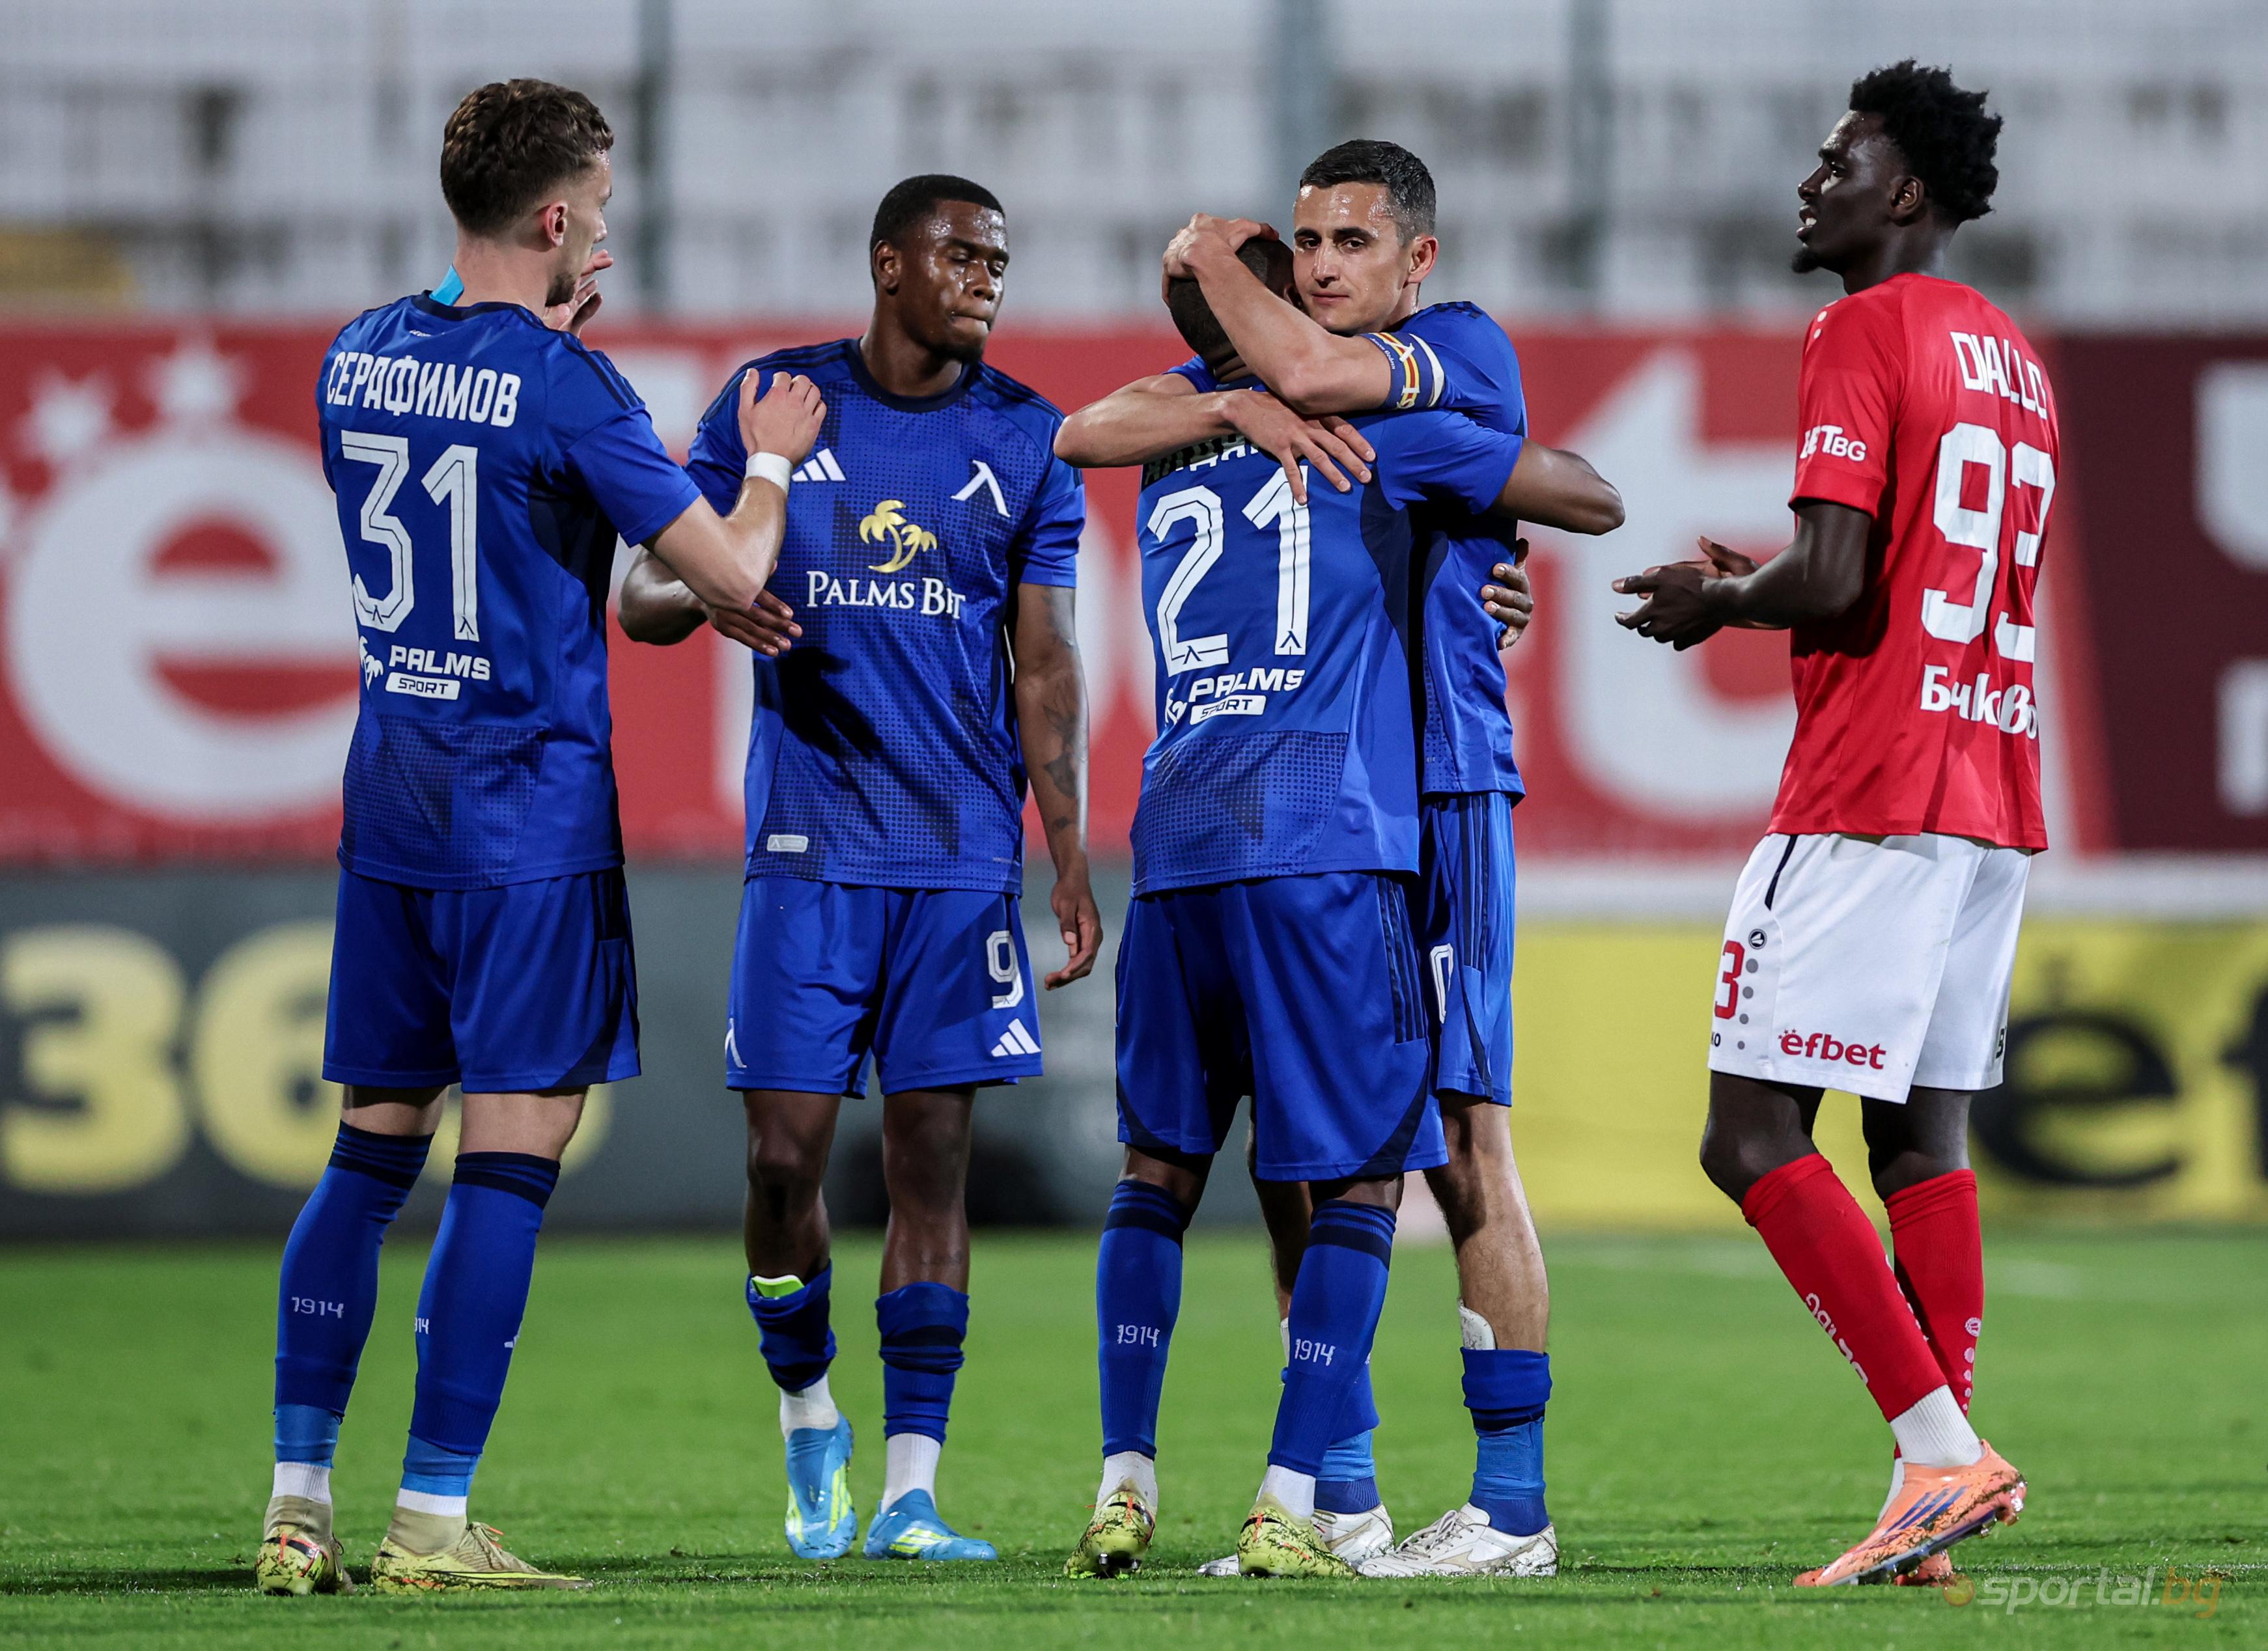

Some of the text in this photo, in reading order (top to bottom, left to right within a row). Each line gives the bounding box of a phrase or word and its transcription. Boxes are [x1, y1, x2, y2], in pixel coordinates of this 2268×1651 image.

[327, 352, 521, 428] СЕРАФИМОВ
[1950, 331, 2048, 420] DIALLO
[341, 430, 479, 642] 31
[1921, 422, 2056, 663] 93
[806, 570, 915, 609] PALMS
[1147, 465, 1310, 677] 21
[389, 645, 490, 681] PALMS
[398, 678, 449, 695] SPORT
[1188, 668, 1306, 702] PALMS
[1200, 699, 1253, 719] SPORT
[986, 930, 1024, 1009] 9
[1778, 1029, 1886, 1070] efbet
[291, 1296, 344, 1319] 1914
[1117, 1324, 1160, 1348] 1914
[1294, 1338, 1336, 1367] 1914
